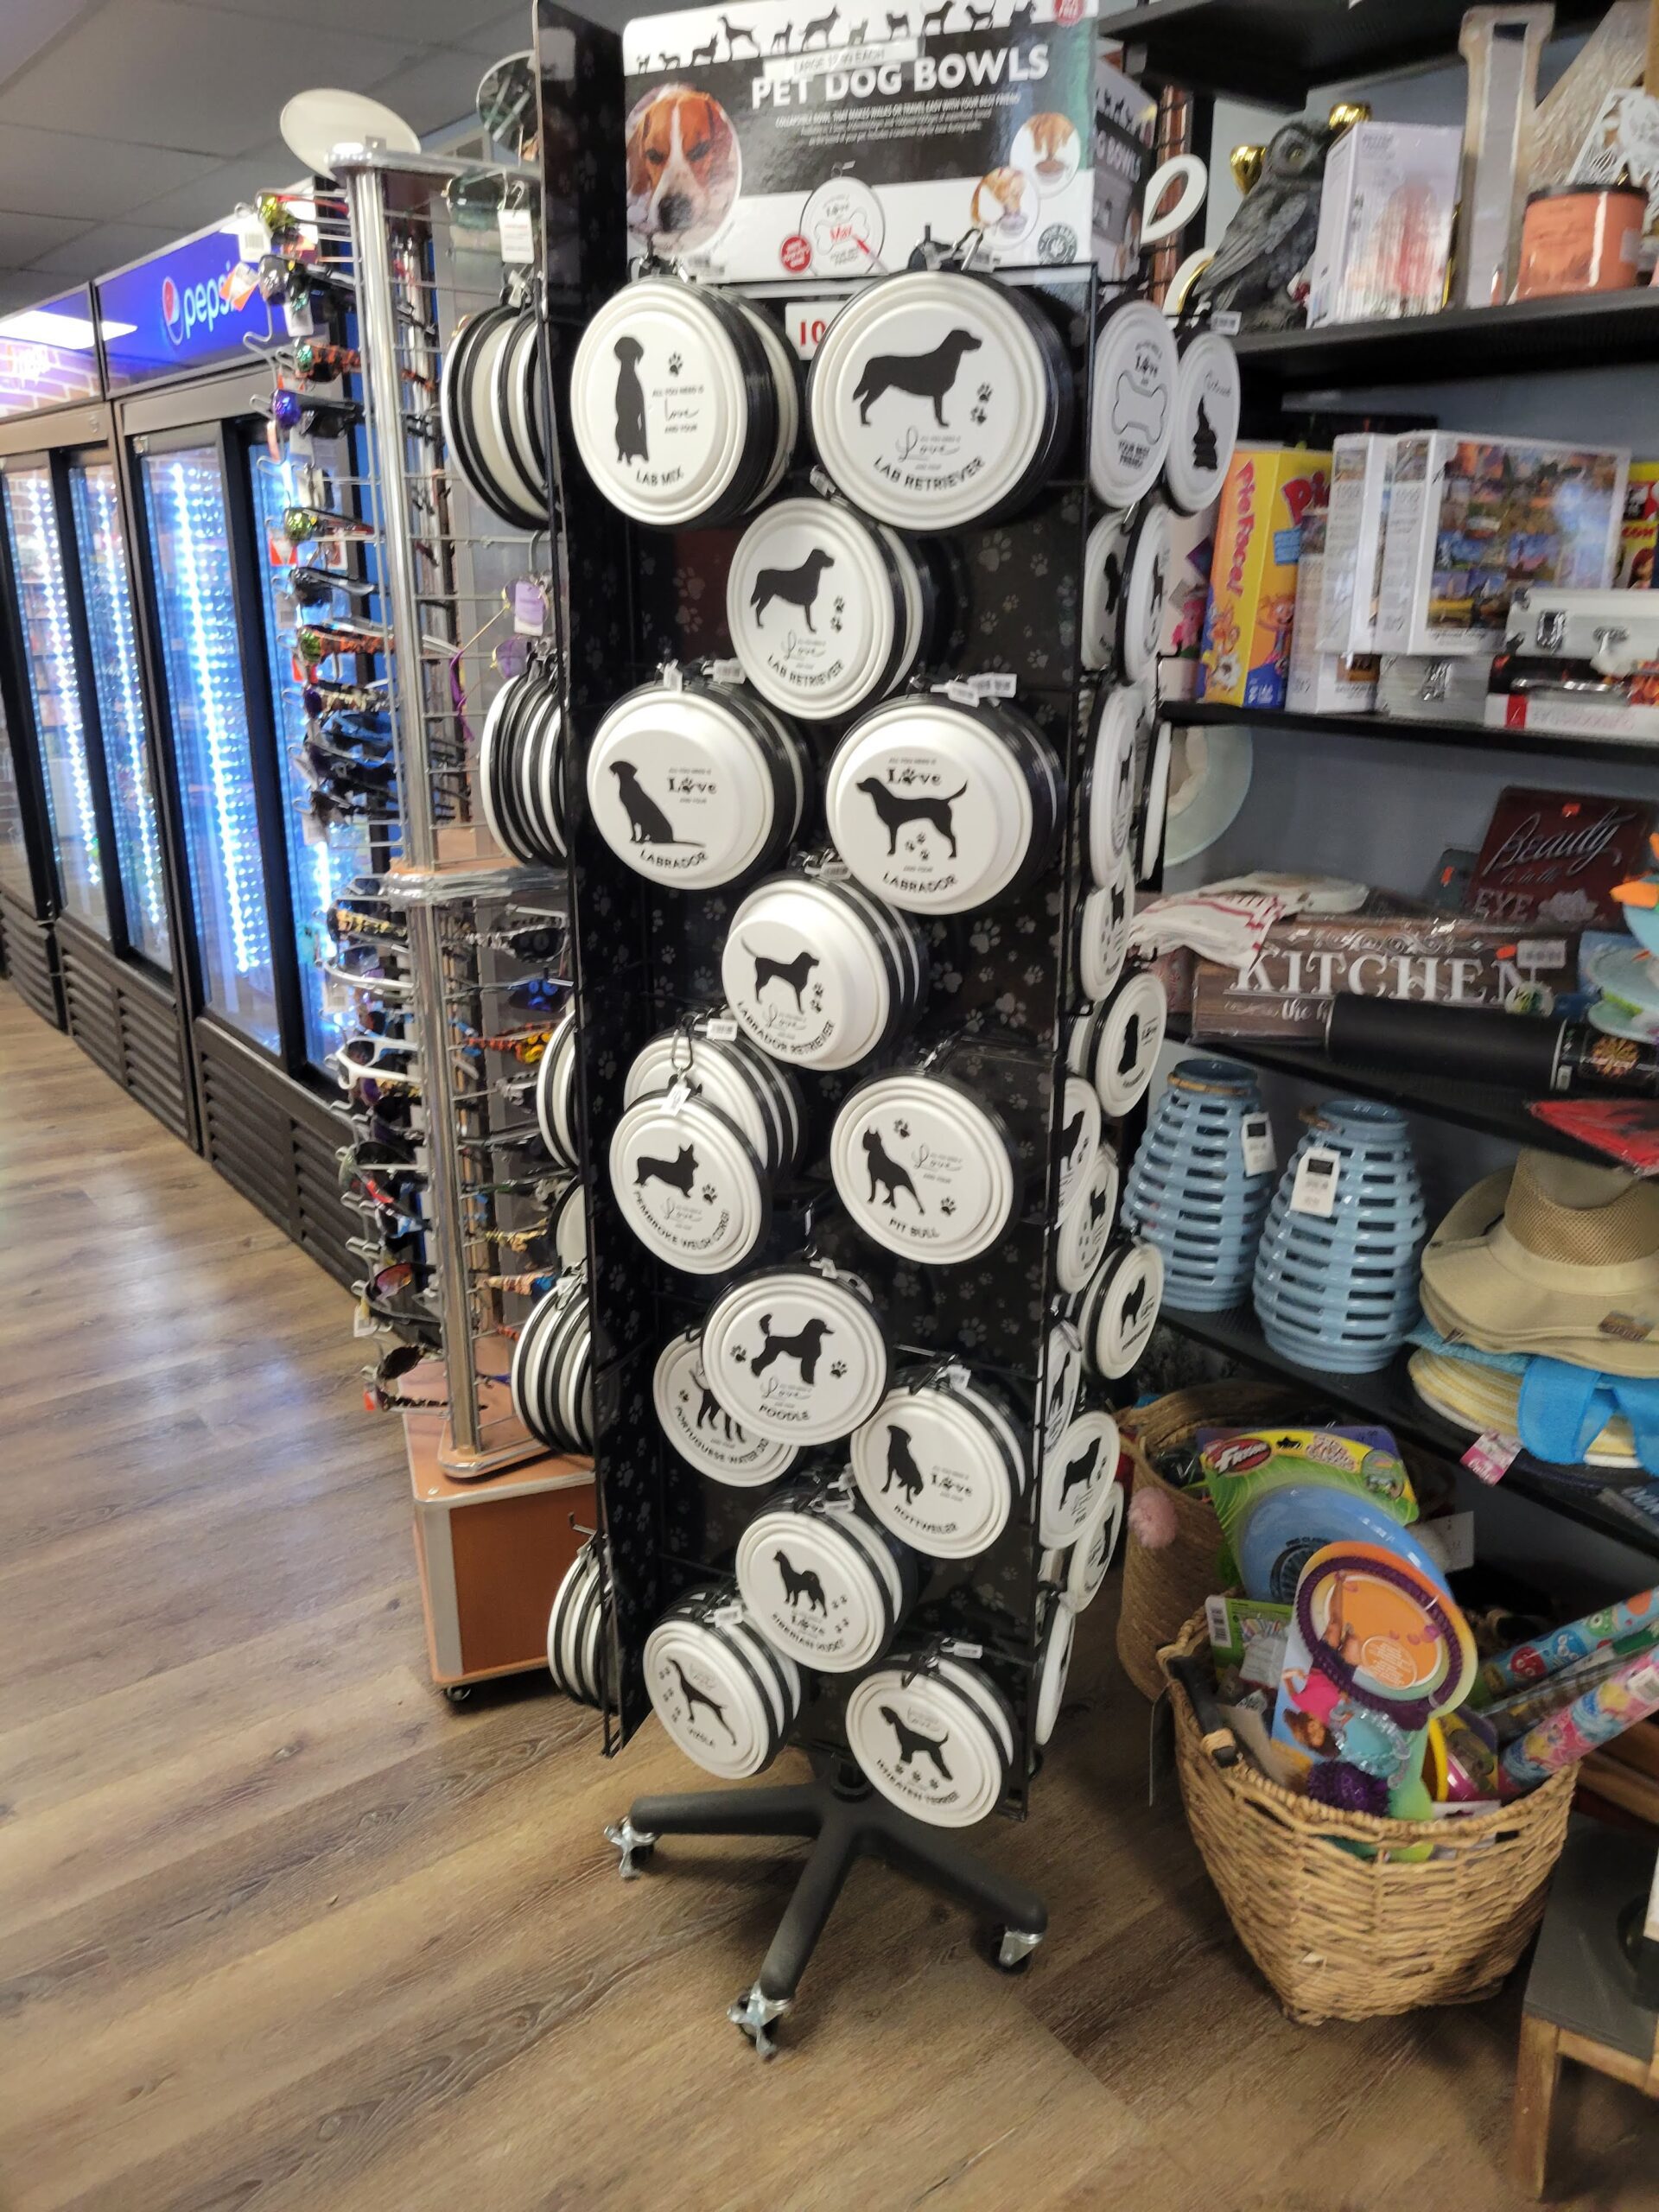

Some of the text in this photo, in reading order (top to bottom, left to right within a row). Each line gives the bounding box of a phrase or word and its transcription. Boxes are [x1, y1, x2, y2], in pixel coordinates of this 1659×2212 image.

[752, 44, 1050, 110] PET DOG BOWLS
[636, 470, 658, 486] LAB
[874, 454, 986, 492] LAB RETRIEVER
[766, 654, 843, 688] LAB RETRIEVER
[666, 777, 717, 795] Love
[886, 766, 942, 787] Love
[1481, 805, 1637, 876] Beauty
[639, 849, 708, 869] LABRADOR
[882, 872, 958, 893] LABRADOR
[1472, 888, 1535, 922] EYE
[1230, 942, 1526, 1006] KITCHEN
[1281, 998, 1312, 1022] the
[736, 1001, 836, 1055] LABRADOR RETRIEVER
[632, 1190, 677, 1245] PEMBROKE
[888, 1217, 940, 1239] PIT BULL
[758, 1404, 810, 1422] POODLE
[674, 1404, 727, 1463] PORTUGUESE
[893, 1504, 959, 1535] ROTTWEILER
